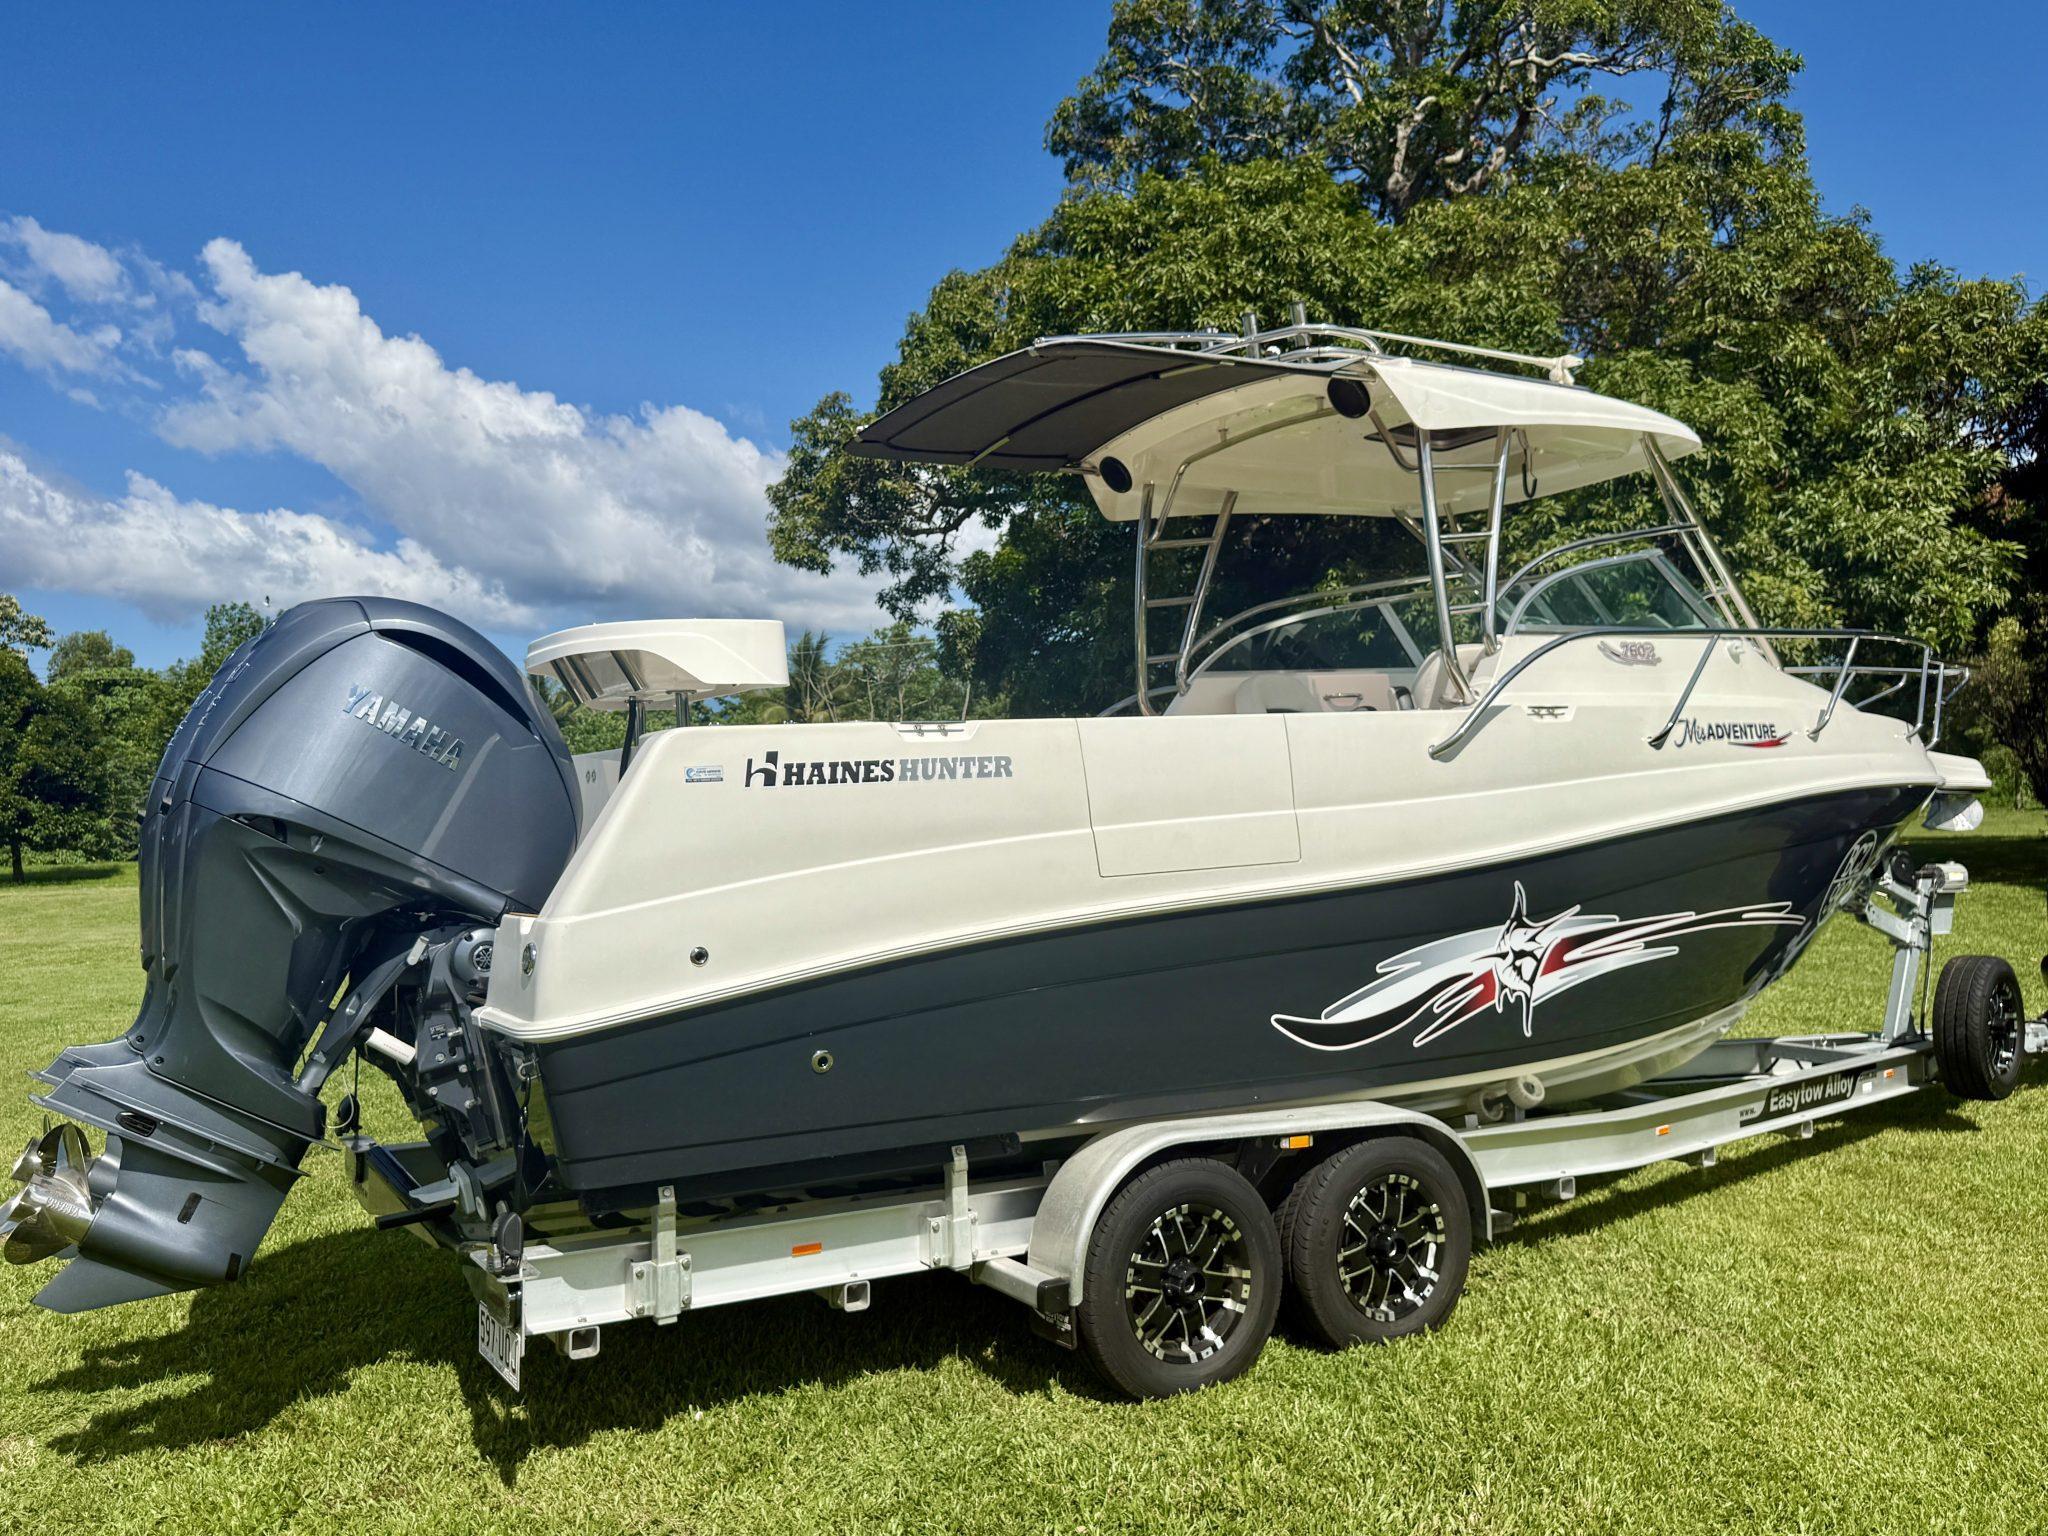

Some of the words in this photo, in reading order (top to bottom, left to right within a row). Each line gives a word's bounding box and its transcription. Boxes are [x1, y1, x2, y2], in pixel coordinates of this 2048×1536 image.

[343, 683, 465, 772] YAMAHA
[783, 760, 895, 786] HAINES
[899, 756, 1013, 781] HUNTER
[1769, 1084, 1825, 1113] Easytow
[1825, 1073, 1854, 1098] Alloy
